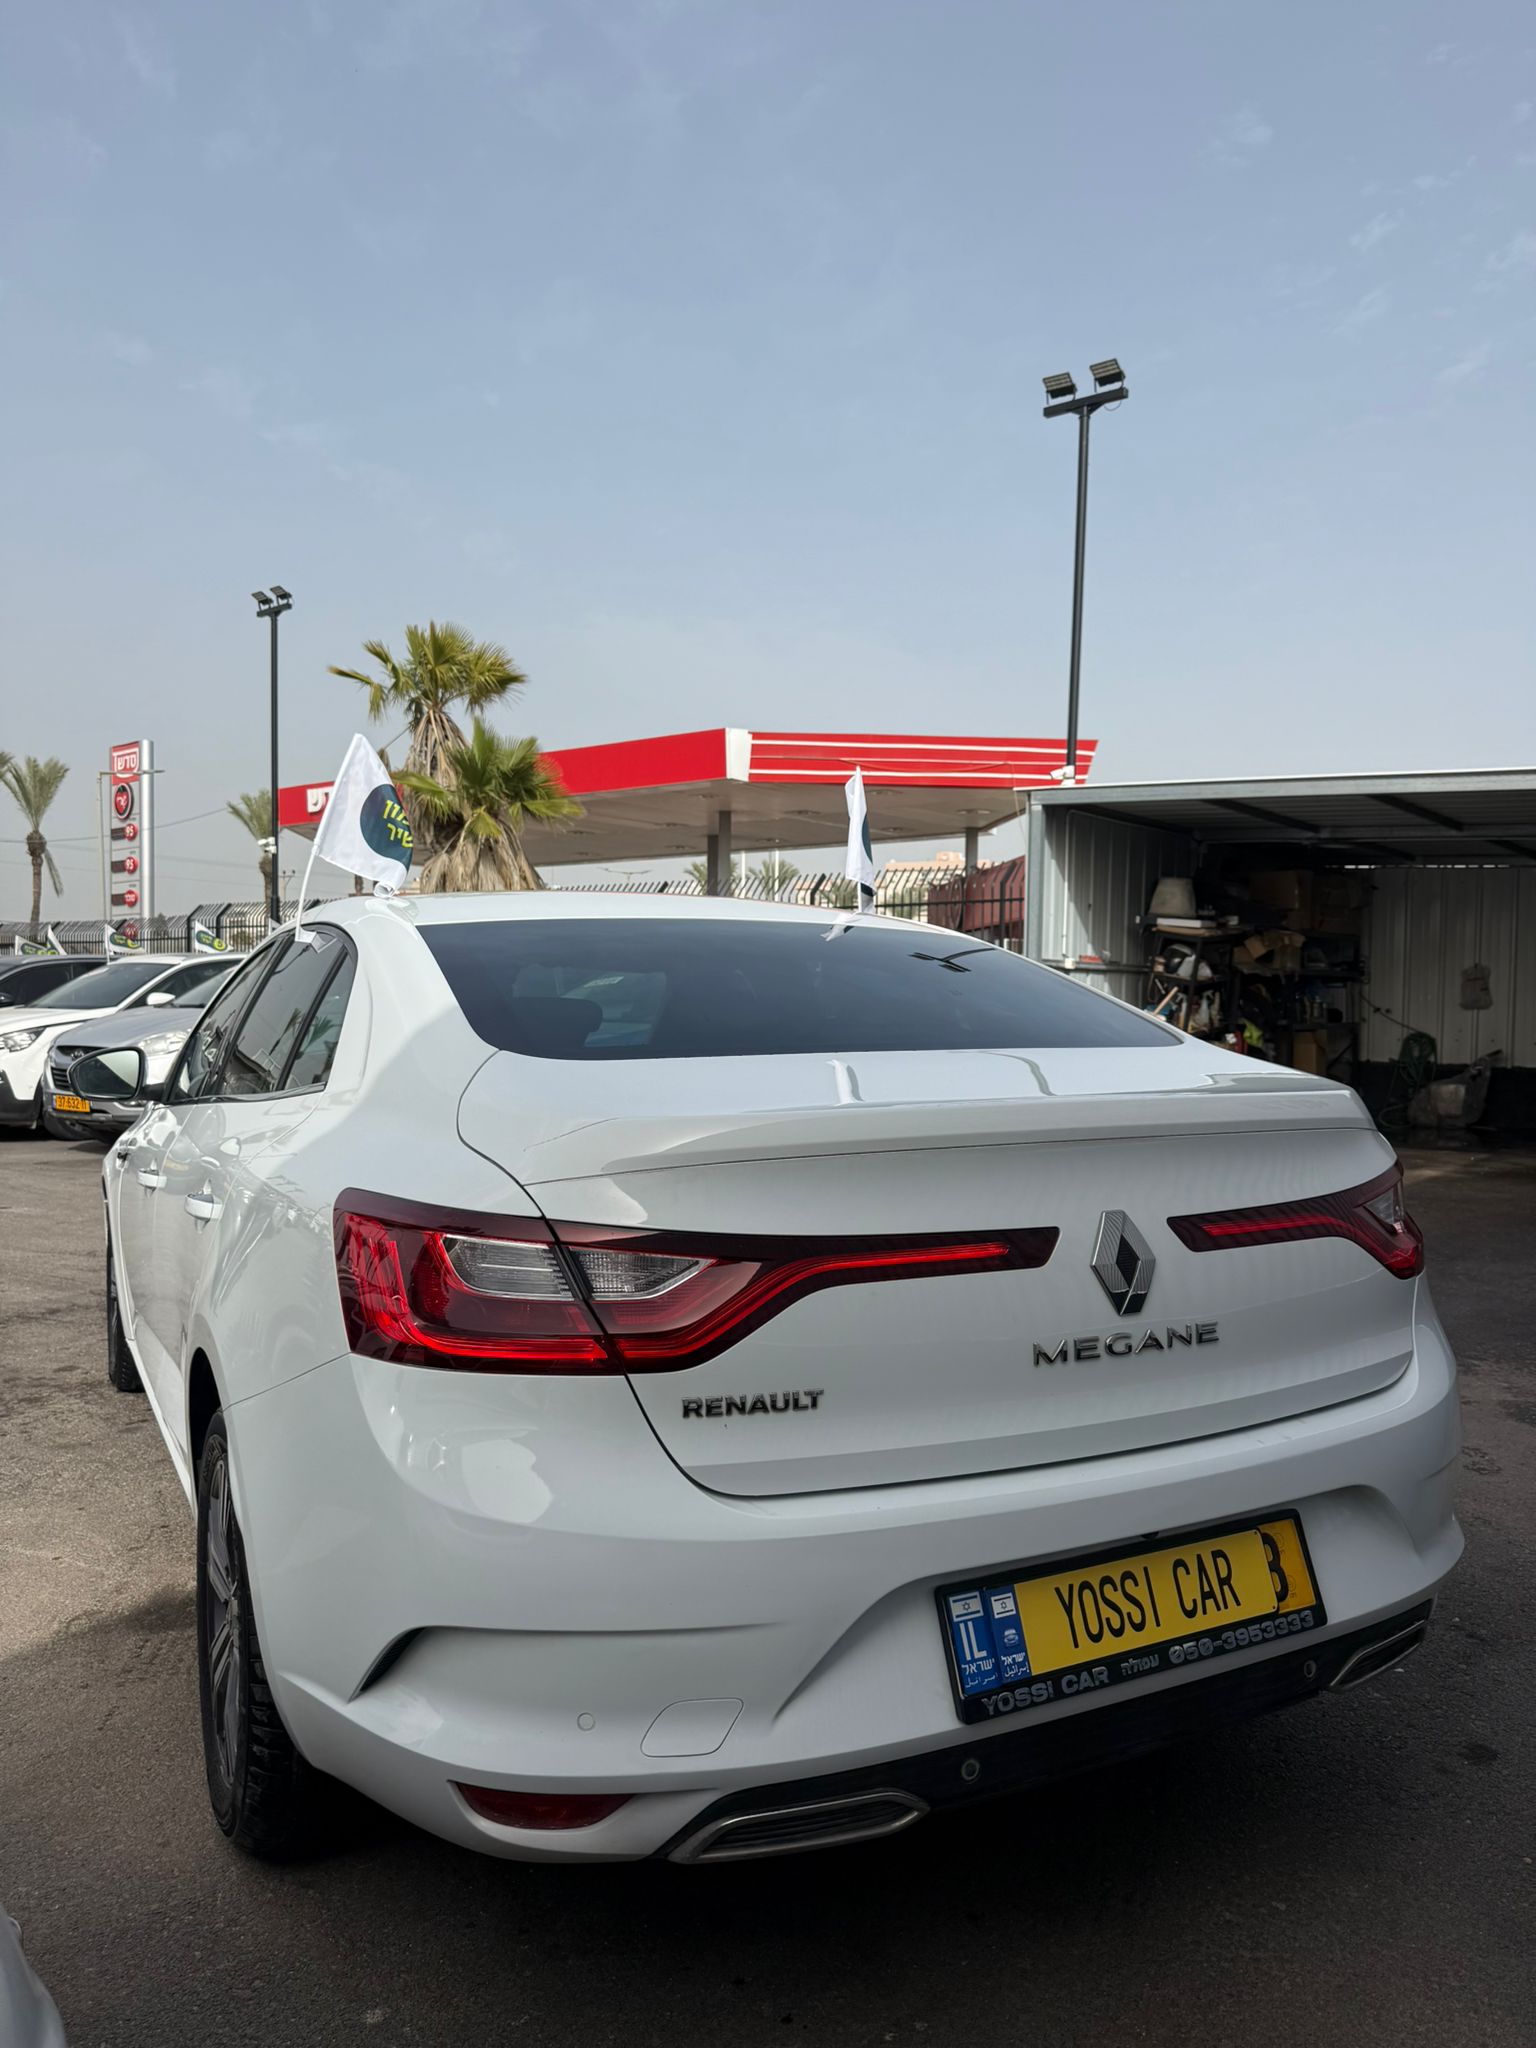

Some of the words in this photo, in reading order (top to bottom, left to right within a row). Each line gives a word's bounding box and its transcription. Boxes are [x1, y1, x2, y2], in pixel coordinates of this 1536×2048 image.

[1033, 1321, 1220, 1367] MEGANE
[681, 1388, 825, 1420] RENAULT
[1054, 1565, 1162, 1650] YOSSI
[1172, 1548, 1242, 1619] CAR
[959, 1620, 988, 1661] IL
[1001, 1652, 1026, 1666] ישראל
[961, 1657, 996, 1676] ישראל
[981, 1680, 1055, 1716] YOSSI
[1061, 1666, 1111, 1695] CAR
[1168, 1609, 1315, 1665] 050-3953333
